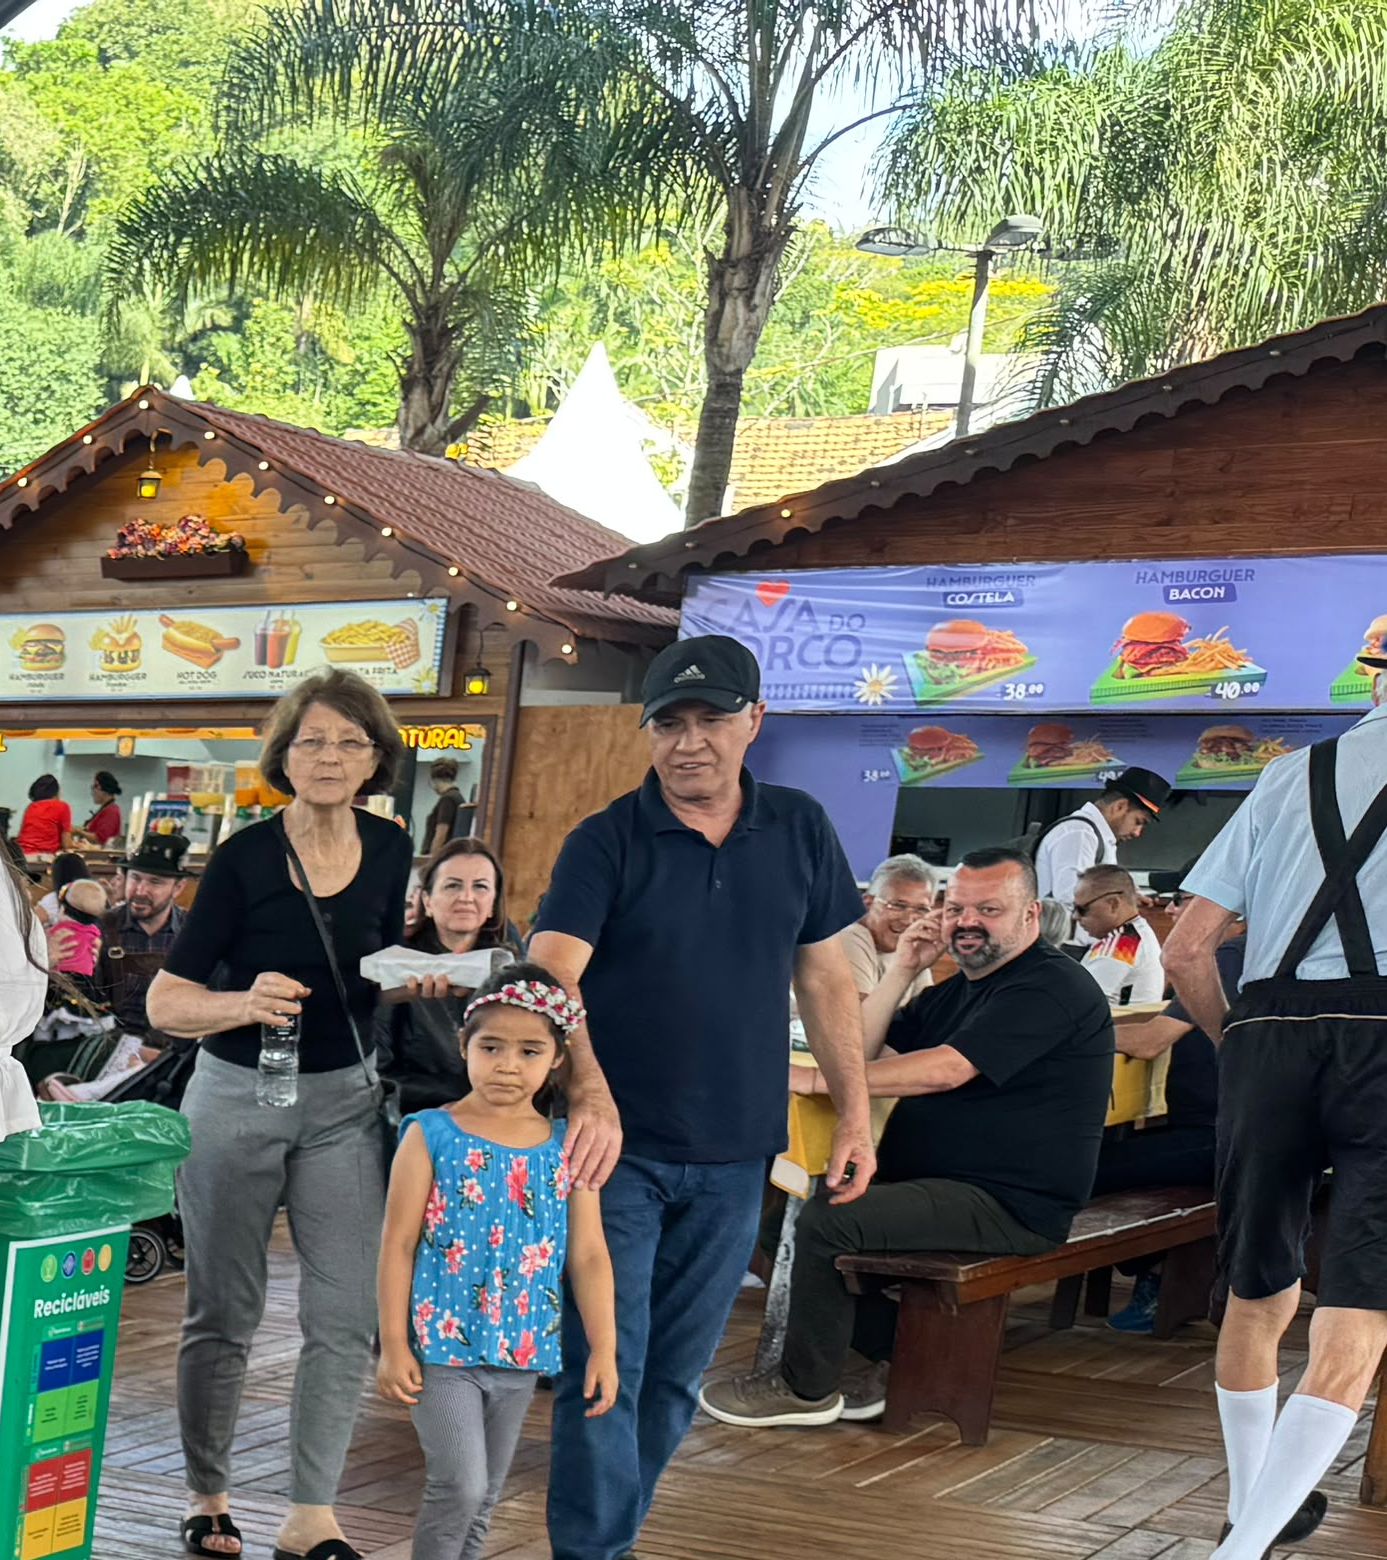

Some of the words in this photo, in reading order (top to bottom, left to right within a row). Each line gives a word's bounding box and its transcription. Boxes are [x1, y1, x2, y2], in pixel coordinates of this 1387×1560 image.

[927, 575, 1036, 587] HAMBURGUER
[1136, 569, 1255, 584] HAMBURGUER
[947, 591, 1015, 605] COSTELA
[1169, 587, 1225, 600] BACON
[828, 613, 865, 632] DO
[740, 634, 863, 671] ORCO
[9, 673, 64, 681] HAMBURGUER
[89, 672, 147, 681] HAMBURGUER
[1214, 681, 1260, 700] 40.00
[33, 1284, 110, 1318] Recicláveis
